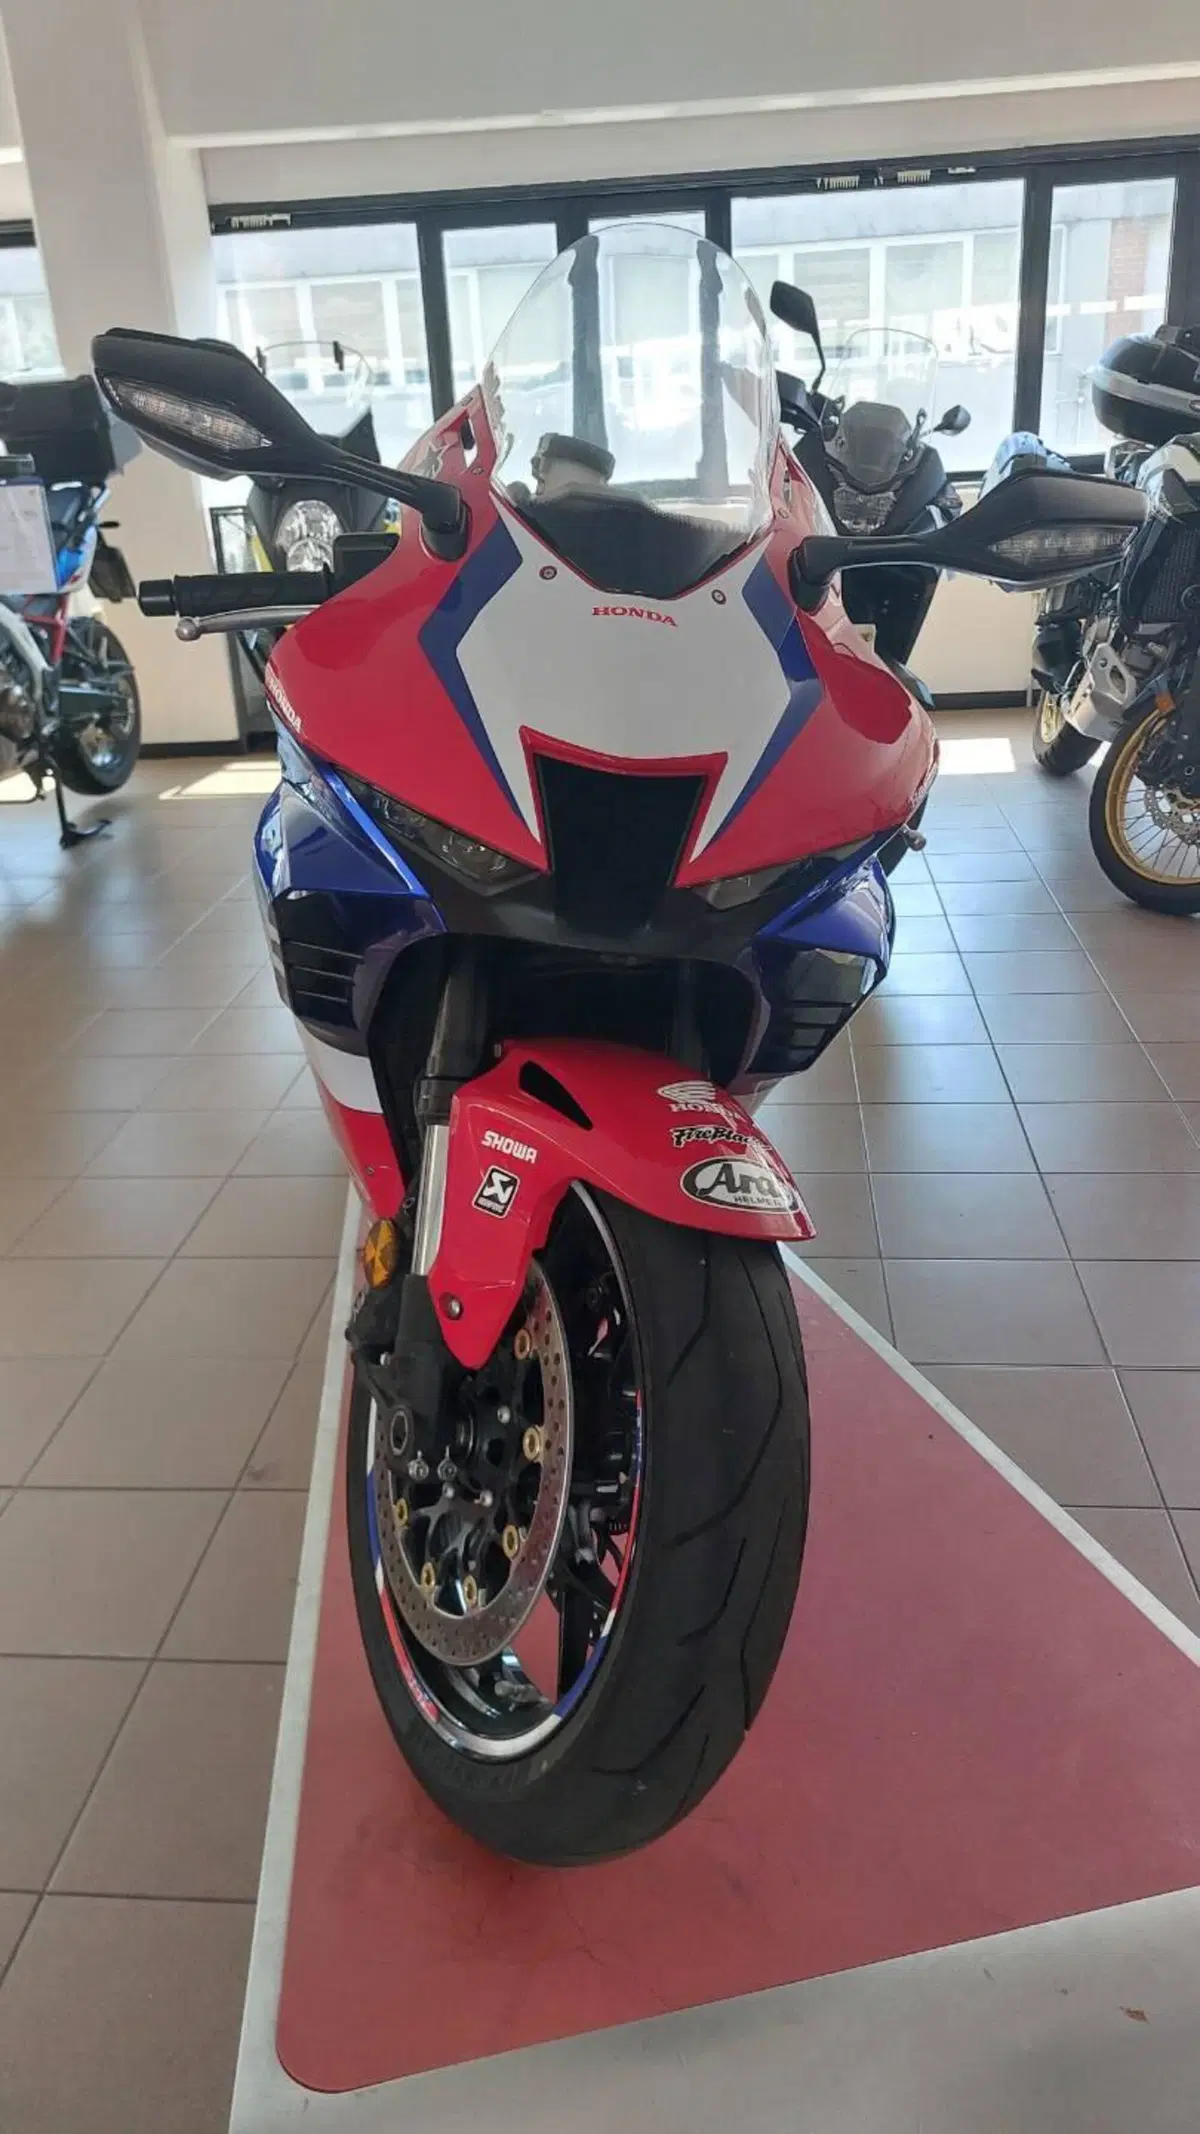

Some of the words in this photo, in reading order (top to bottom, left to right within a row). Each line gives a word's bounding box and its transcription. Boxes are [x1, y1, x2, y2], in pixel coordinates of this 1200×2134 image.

[592, 606, 679, 627] HONDA
[481, 1130, 538, 1164] SHOWA
[697, 1162, 788, 1198] Ara
